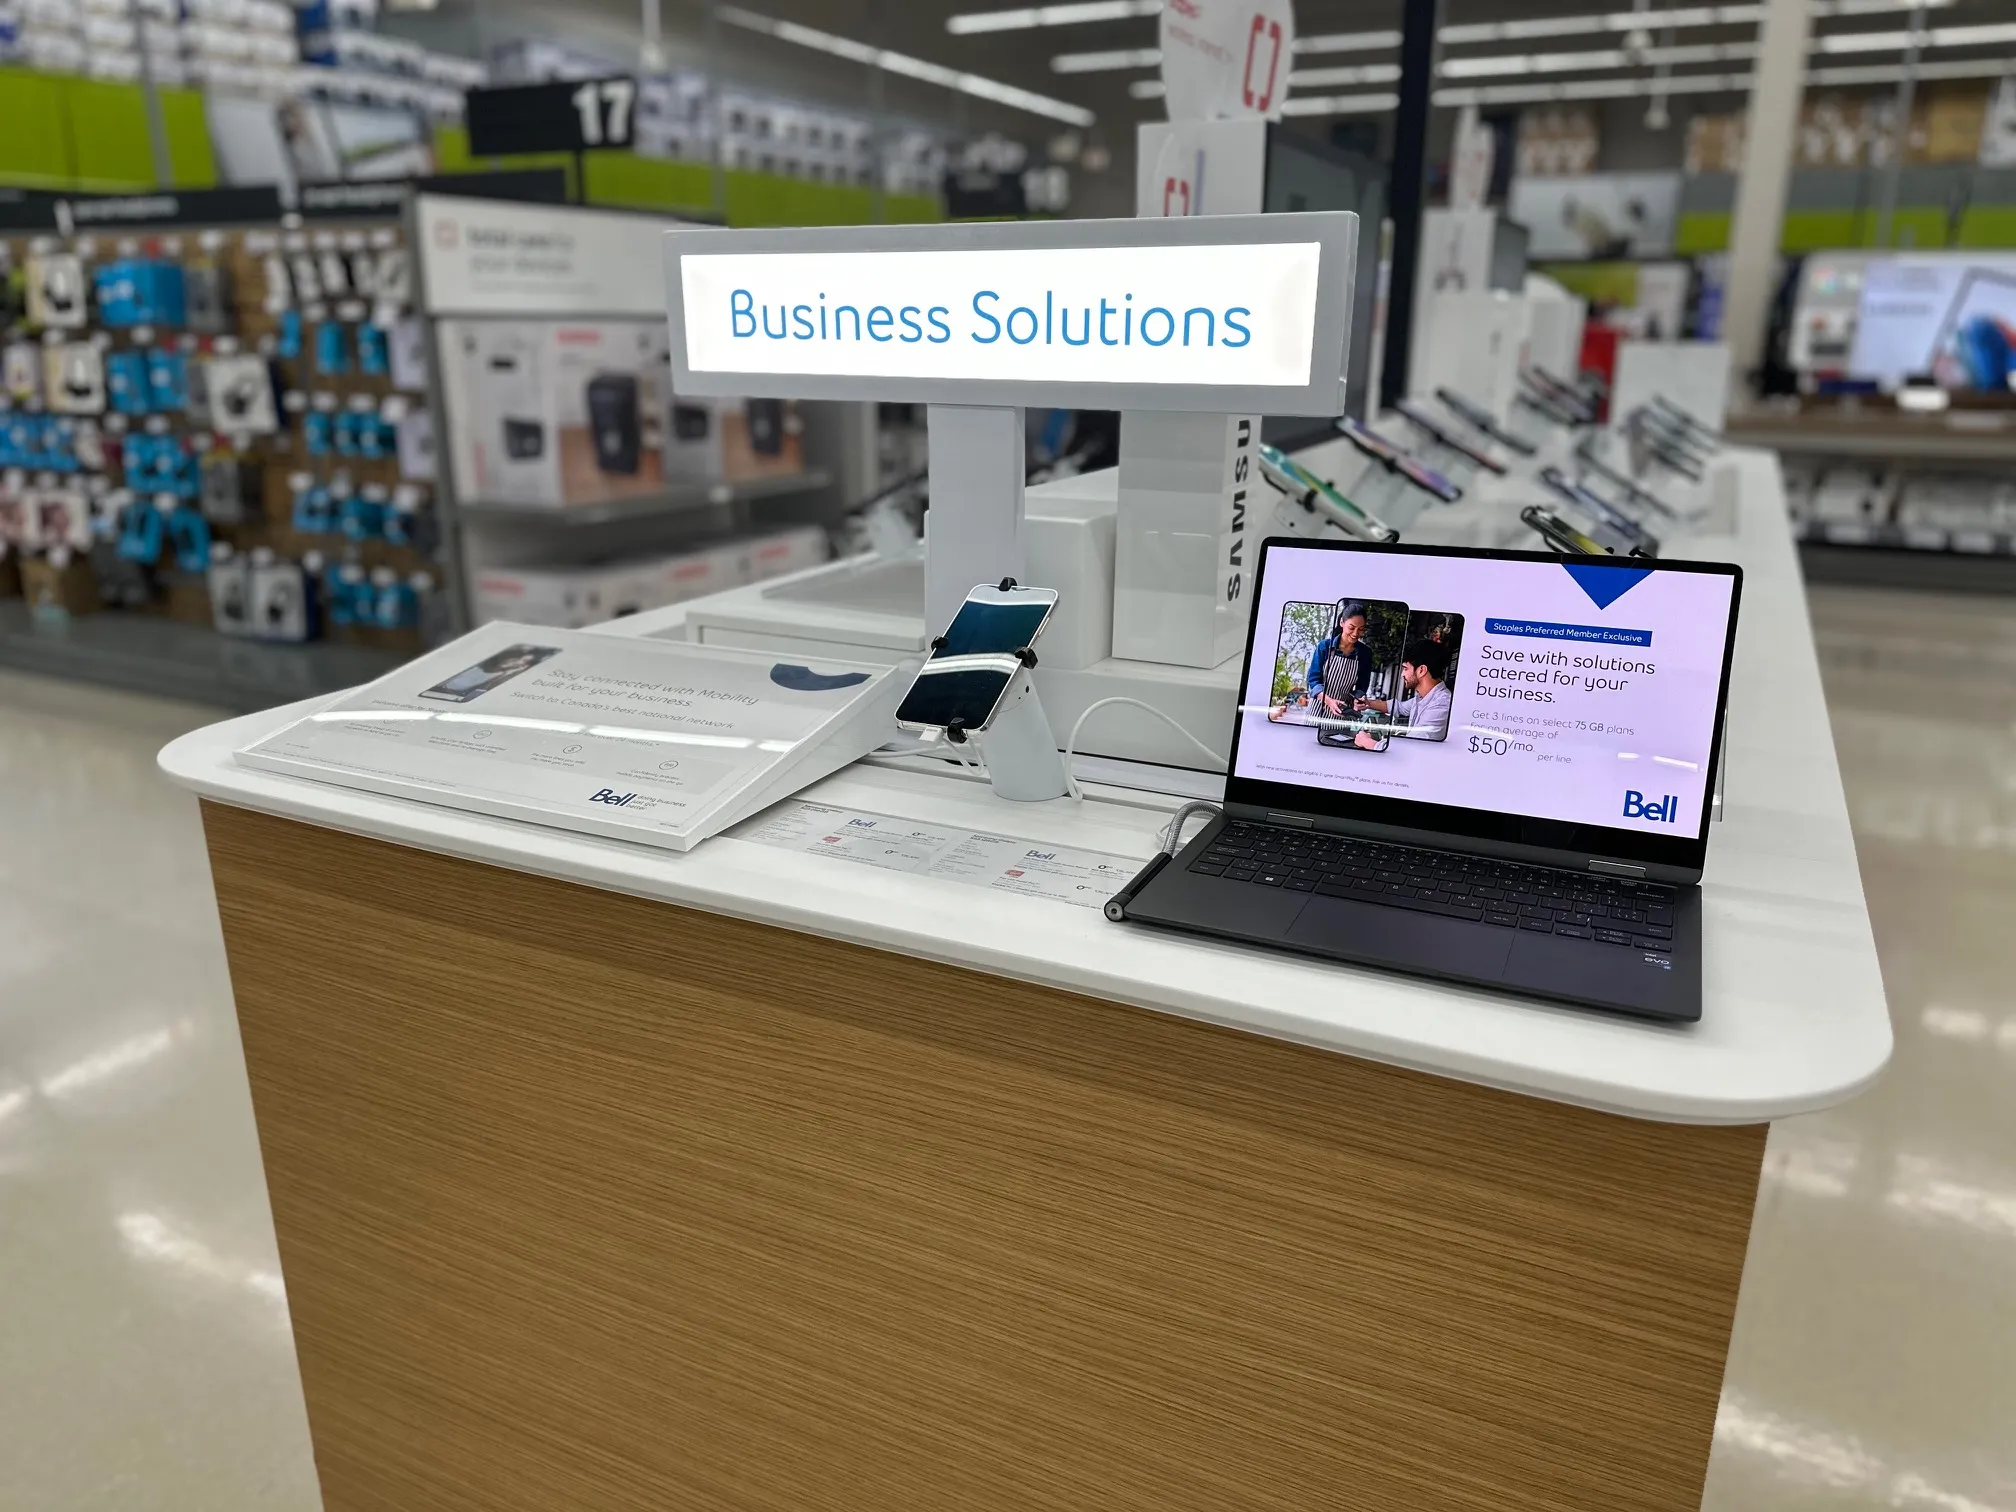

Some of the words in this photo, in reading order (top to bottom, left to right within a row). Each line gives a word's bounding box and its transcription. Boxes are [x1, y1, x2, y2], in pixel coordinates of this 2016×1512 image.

[572, 80, 635, 145] 17
[731, 288, 951, 344] Business
[971, 290, 1252, 348] Solutions
[1227, 419, 1251, 601] SAMSU
[1493, 623, 1524, 633] Staples
[1525, 625, 1565, 636] Preferred
[1566, 628, 1602, 639] Member
[1603, 632, 1643, 643] Exclusive
[1481, 645, 1525, 663] Save
[1530, 651, 1568, 666] with
[1573, 655, 1656, 675] solutions
[531, 679, 565, 689] built
[565, 683, 590, 691] for
[588, 688, 628, 697] your
[548, 669, 582, 681] Stay
[584, 675, 662, 690] connected
[662, 685, 695, 696] with
[697, 689, 760, 706] Mobility
[1478, 667, 1548, 683] catered
[1553, 671, 1580, 686] for
[1584, 676, 1628, 692] your
[1476, 682, 1556, 703] business.
[510, 691, 546, 701] Switch
[560, 698, 610, 711] Canada's
[612, 706, 638, 715] best
[638, 709, 686, 721] national
[686, 718, 735, 729] network
[1472, 710, 1490, 720] Get
[1492, 712, 1499, 721] 3
[1501, 713, 1524, 724] lines
[1526, 716, 1540, 726] on
[1542, 717, 1573, 729] select
[1575, 720, 1587, 731] 75
[1589, 722, 1604, 732] GB
[1606, 724, 1635, 736] plans
[1502, 727, 1544, 740] average
[1547, 731, 1559, 740] of
[1537, 753, 1553, 762] per
[1555, 753, 1572, 764] line
[588, 788, 638, 807] Bell
[1623, 790, 1678, 823] Bell
[847, 818, 877, 828] Bell
[1025, 849, 1057, 860] Bell
